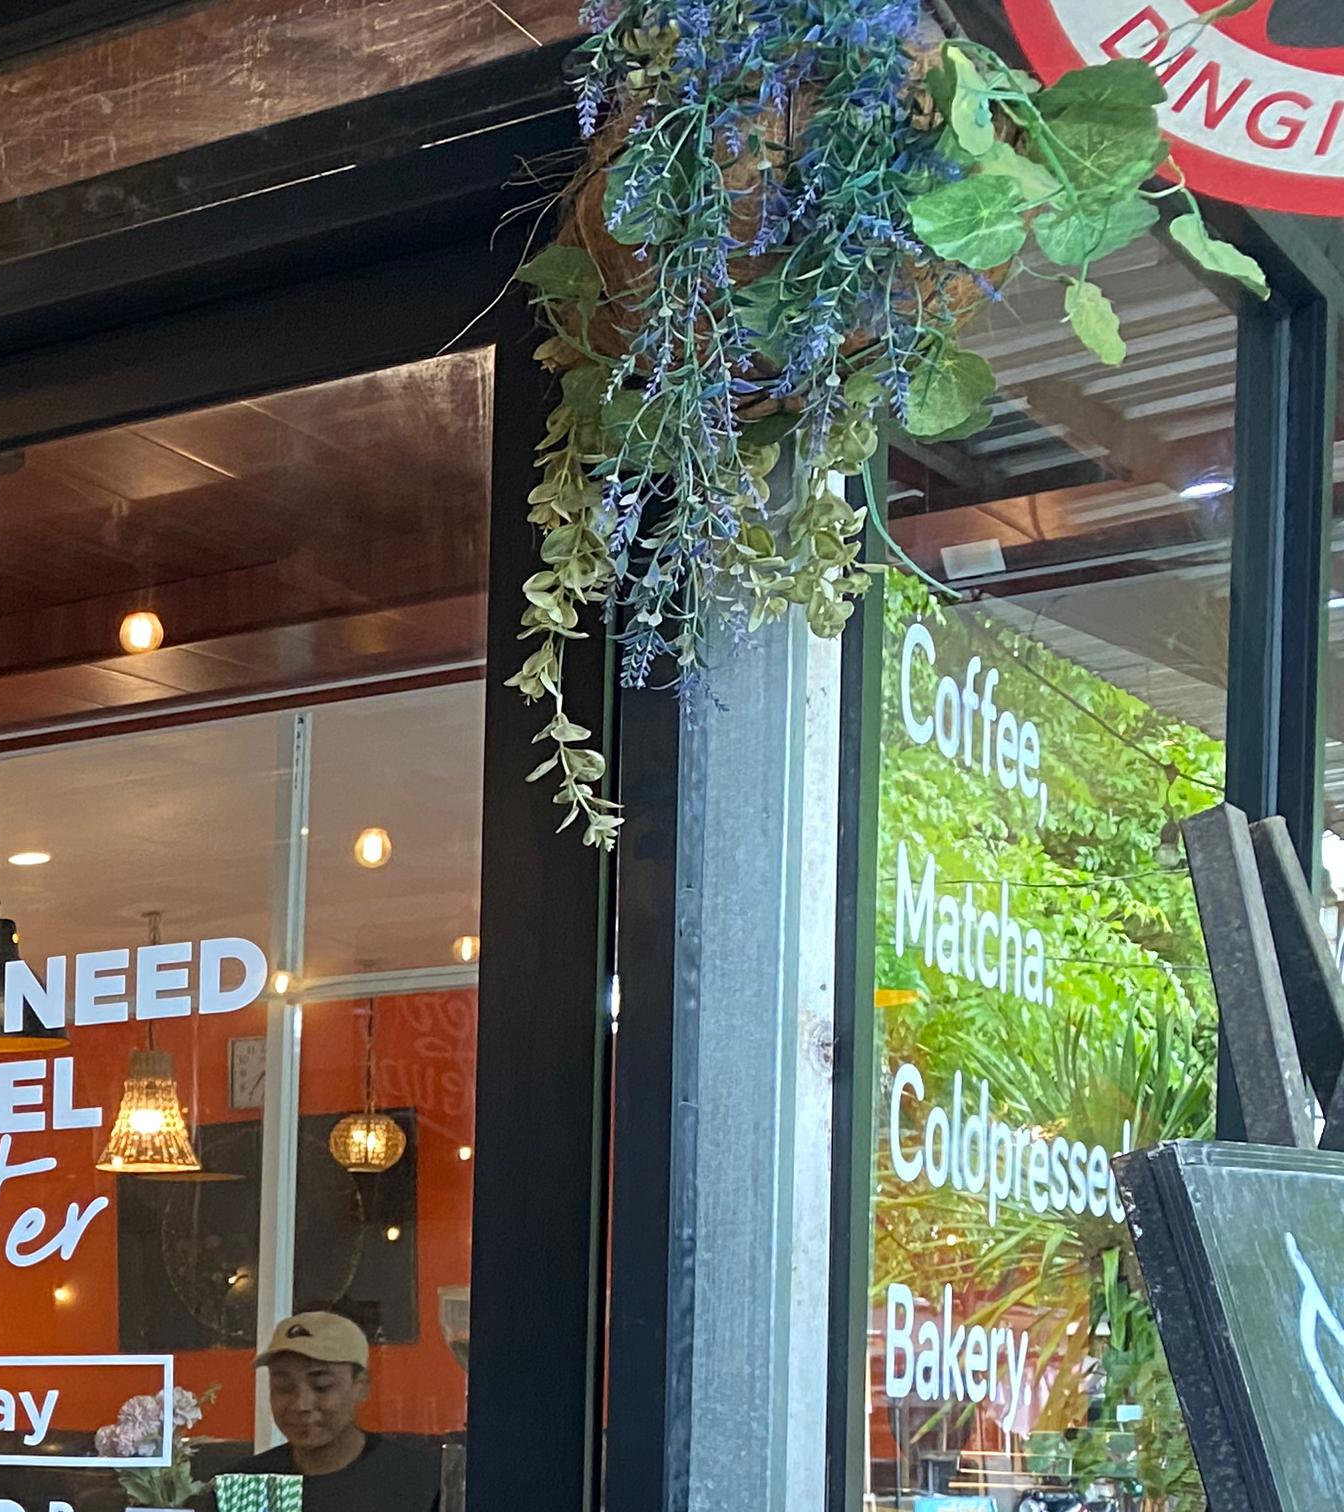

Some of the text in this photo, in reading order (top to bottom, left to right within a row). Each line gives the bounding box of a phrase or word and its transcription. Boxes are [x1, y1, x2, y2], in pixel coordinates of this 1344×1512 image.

[899, 623, 1048, 826] Coffee,
[2, 937, 269, 1034] NEED
[894, 841, 1054, 1008] Matcha.
